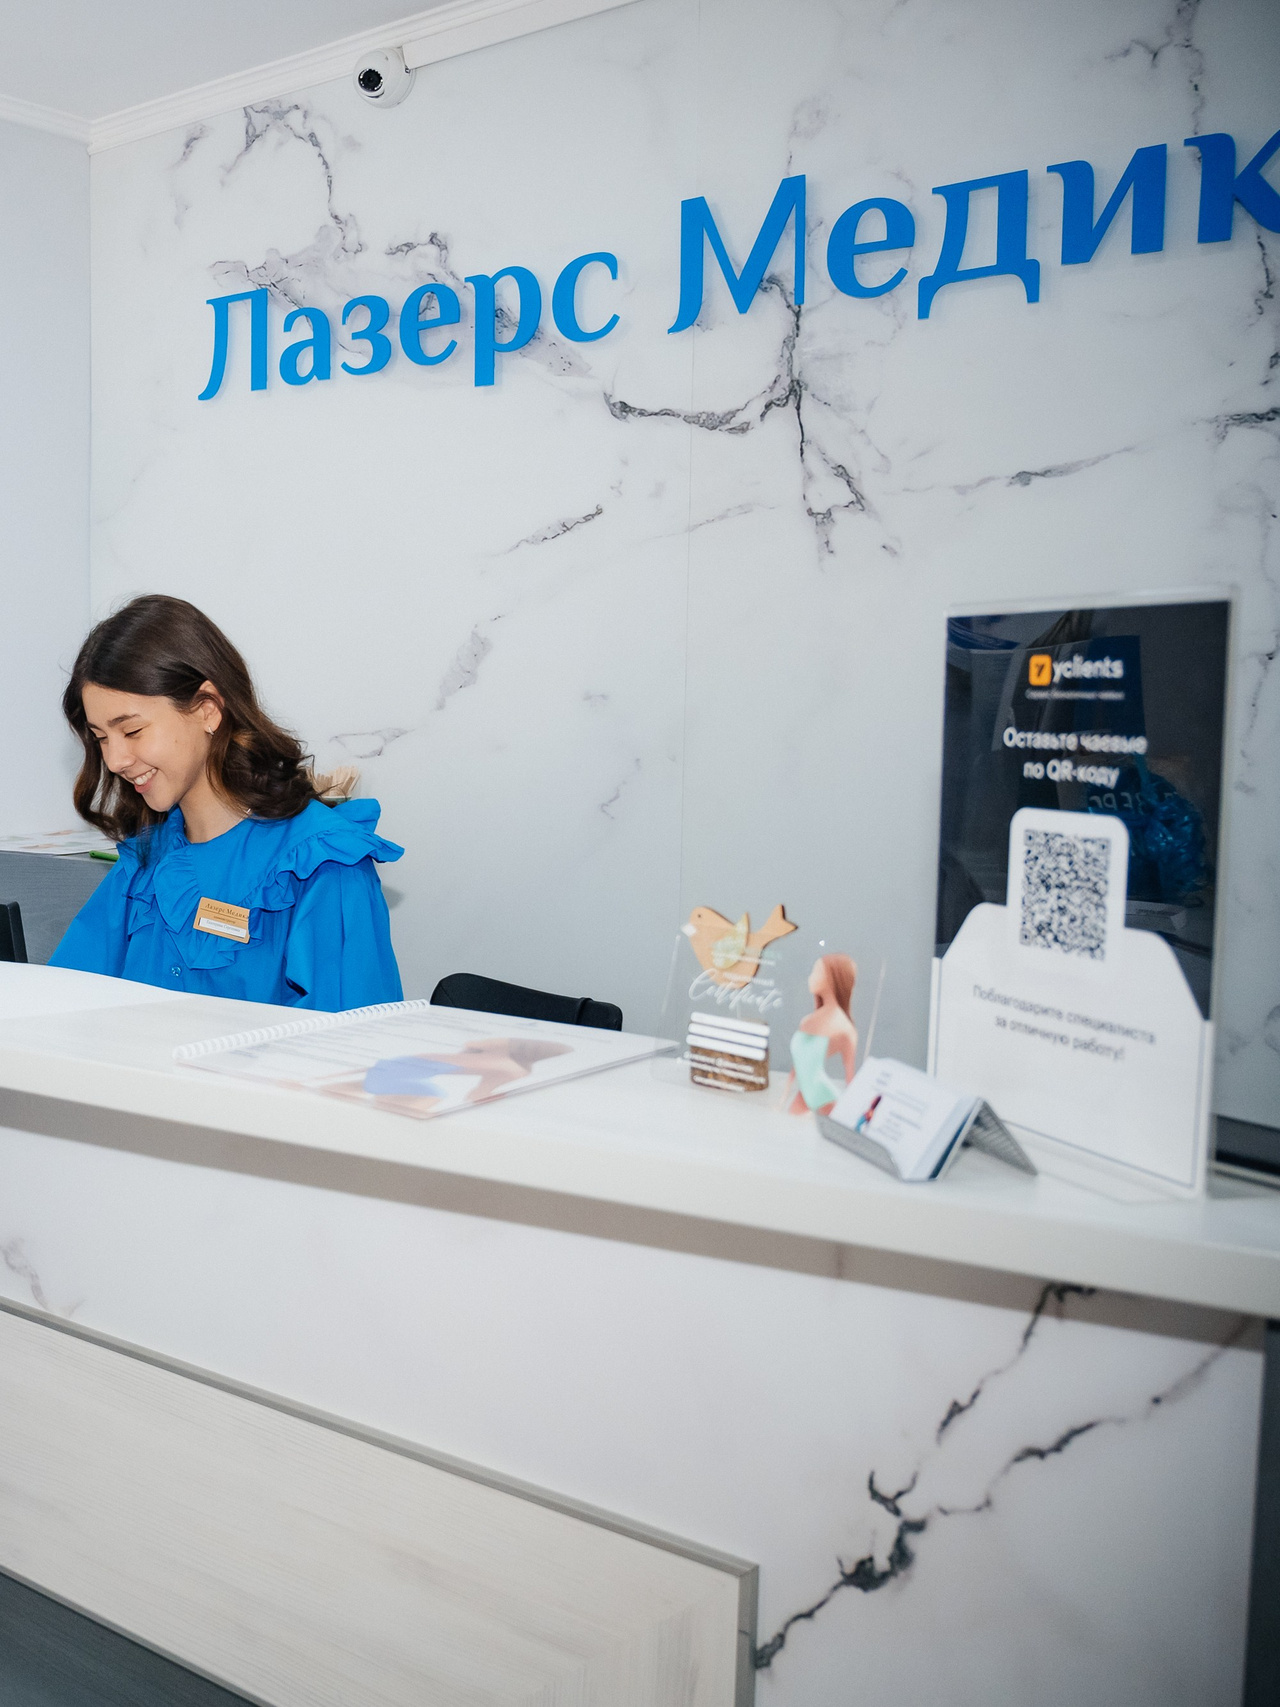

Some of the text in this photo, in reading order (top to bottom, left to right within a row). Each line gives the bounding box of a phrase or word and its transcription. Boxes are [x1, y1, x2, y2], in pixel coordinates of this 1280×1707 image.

[198, 132, 1280, 402] Лазерс Медик
[1003, 726, 1079, 751] Оставьте
[1023, 759, 1120, 790] по QR-коду
[973, 984, 1157, 1044] Поблагодарите специалиста
[995, 1016, 1008, 1028] за
[1009, 1019, 1070, 1046] отличную
